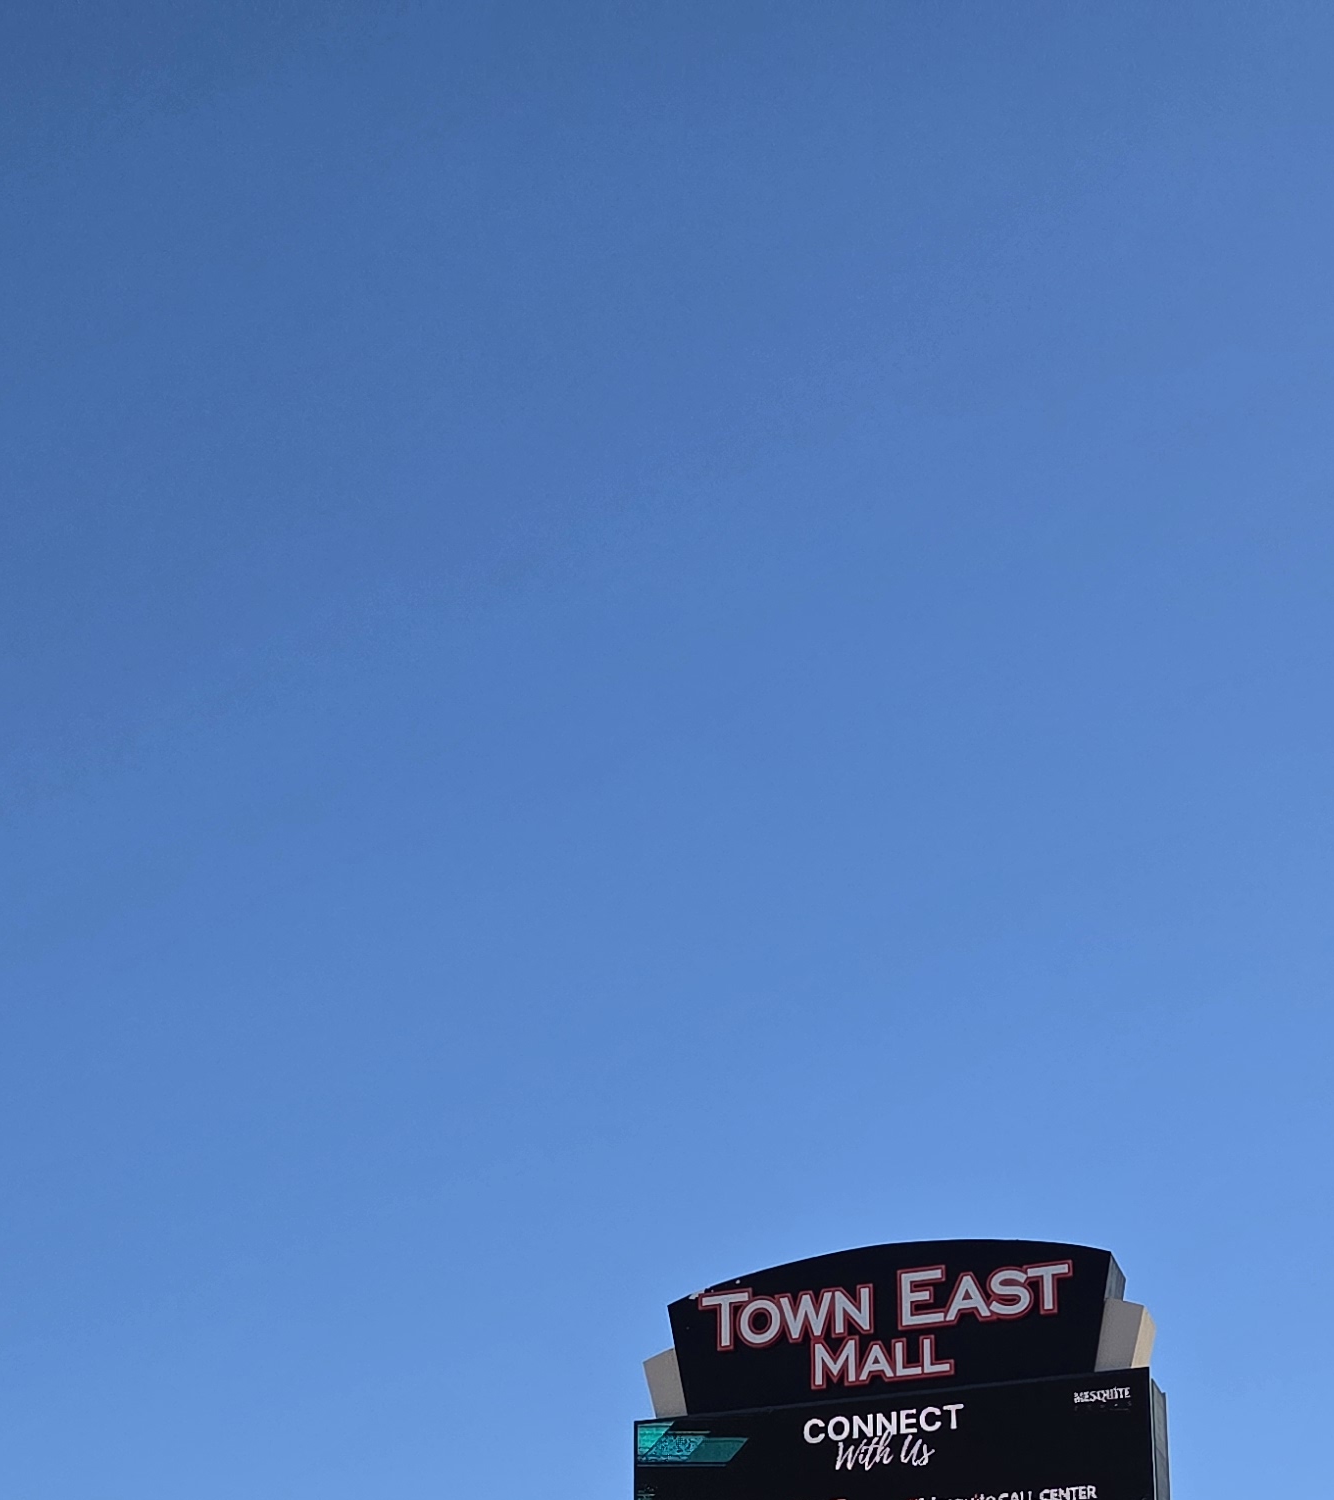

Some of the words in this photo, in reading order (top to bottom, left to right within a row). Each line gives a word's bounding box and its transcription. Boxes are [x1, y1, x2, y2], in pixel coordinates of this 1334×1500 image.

[803, 1404, 964, 1443] CONNECT
[835, 1428, 894, 1471] With
[900, 1434, 935, 1467] Us
